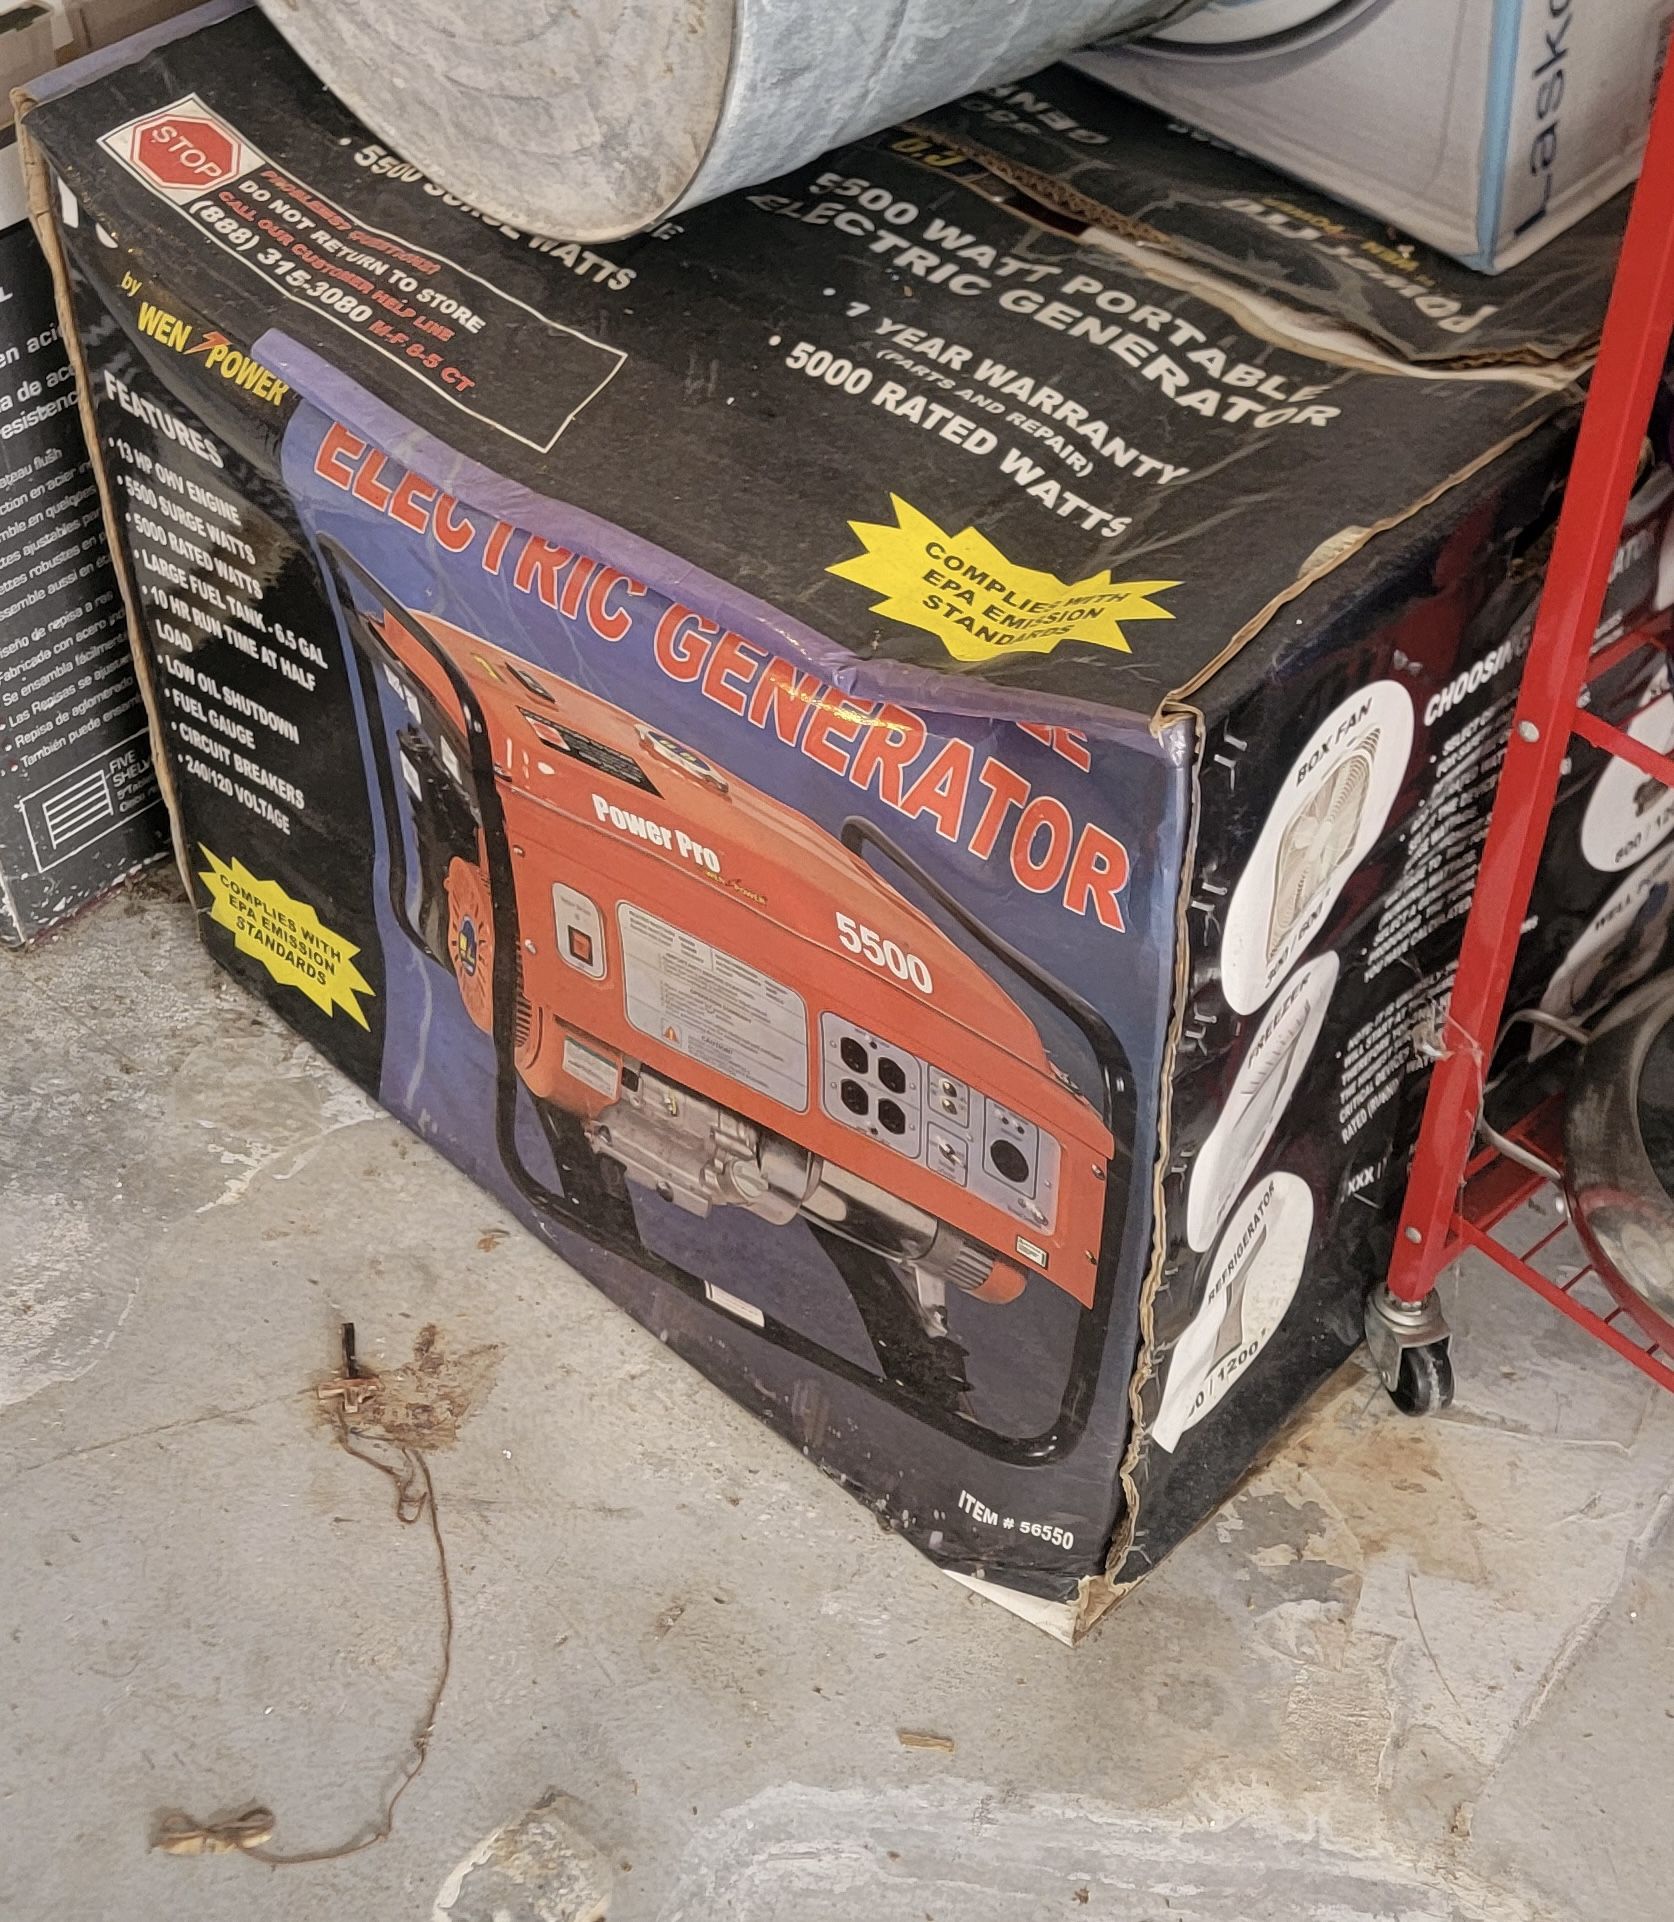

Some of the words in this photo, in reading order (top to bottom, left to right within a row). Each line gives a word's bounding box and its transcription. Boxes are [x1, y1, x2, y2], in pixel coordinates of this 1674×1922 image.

[152, 126, 222, 177] STOP
[121, 271, 142, 297] by
[189, 201, 260, 252] (888)
[257, 248, 374, 323] 315-3080
[441, 366, 476, 392] CT
[220, 191, 257, 222] CALL
[258, 219, 295, 247] OUR
[292, 243, 375, 295] CUSTOMER
[371, 290, 417, 318] HELP
[413, 316, 456, 342] LINE
[238, 180, 271, 201] DO
[268, 199, 316, 230] NOT
[310, 230, 390, 276] RETURN
[388, 269, 418, 292] TO
[416, 288, 487, 334] STORE
[528, 235, 637, 290] WATTS
[809, 172, 919, 225] 5500
[923, 219, 1062, 283] WATT
[1061, 274, 1335, 402] PORTABLE
[747, 194, 991, 296] ELECTRIC
[999, 289, 1341, 429] GENERATOR
[17, 381, 42, 402] de
[137, 301, 193, 353] WEN
[204, 344, 289, 406] POWER
[104, 370, 224, 468] FEATURES
[785, 341, 873, 395] 5000
[872, 381, 998, 455] RATED
[999, 448, 1132, 538] WATTS
[875, 318, 973, 371] YEAR
[973, 358, 1190, 485] WARRANTY
[877, 348, 956, 389] (PARTS
[955, 388, 1006, 415] AND
[1006, 411, 1094, 478] REPAIR)
[28, 512, 44, 528] en
[29, 485, 45, 499] en
[116, 438, 134, 463] 13
[134, 448, 153, 474] HP
[155, 462, 184, 494] OHV
[186, 480, 242, 526] ENGINE
[125, 475, 158, 509] 5500
[158, 495, 206, 537] SURGE
[206, 522, 256, 565] WATTS
[133, 513, 167, 545] 5000
[168, 532, 213, 572] RATED
[213, 557, 263, 600] WATTS
[925, 541, 1058, 614] COMPLIES
[31, 627, 46, 642] de
[141, 548, 188, 590] LARGE
[188, 578, 226, 610] FUEL
[226, 596, 267, 633] TANK
[298, 638, 329, 669] GAL
[151, 587, 169, 610] 10
[169, 595, 191, 622] HR
[191, 606, 223, 640] RUN
[223, 623, 259, 659] TIME
[260, 645, 278, 671] AT
[280, 657, 317, 692] HALF
[155, 618, 193, 653] LOAD
[922, 568, 974, 607] EPA
[981, 604, 1107, 632] EMISSION
[922, 594, 1075, 648] STANDARDS
[53, 637, 74, 654] con
[313, 421, 649, 642] ELECTRIC
[653, 601, 1131, 934] GENERATOR
[2, 691, 19, 706] Se
[9, 709, 31, 727] Las
[78, 675, 93, 691] se
[55, 711, 70, 726] de
[166, 655, 196, 685] LOW
[197, 672, 222, 700] OIL
[222, 685, 300, 744] SHUTDOWN
[172, 687, 207, 722] FUEL
[208, 709, 256, 749] GAUGE
[110, 750, 137, 774] FIVE
[179, 722, 232, 766] CIRCUIT
[233, 753, 305, 810] BREAKERS
[1295, 741, 1333, 788] BOX
[1334, 696, 1373, 745] FAN
[185, 754, 234, 797] 240/120
[234, 782, 292, 835] VOLTAGE
[592, 793, 673, 851] Power
[674, 827, 722, 874] Pro
[219, 873, 297, 933] COMPLIES
[301, 925, 342, 964] WITH
[229, 894, 256, 921] EPA
[262, 915, 335, 976] EMISSION
[236, 915, 328, 985] STANDARDS
[835, 911, 934, 994] 5500
[1207, 1180, 1276, 1304] REFRIGERATOR
[1216, 1341, 1260, 1384] 1200
[958, 1489, 998, 1526] ITEM
[1003, 1517, 1015, 1530] #
[1019, 1521, 1074, 1550] 56550
